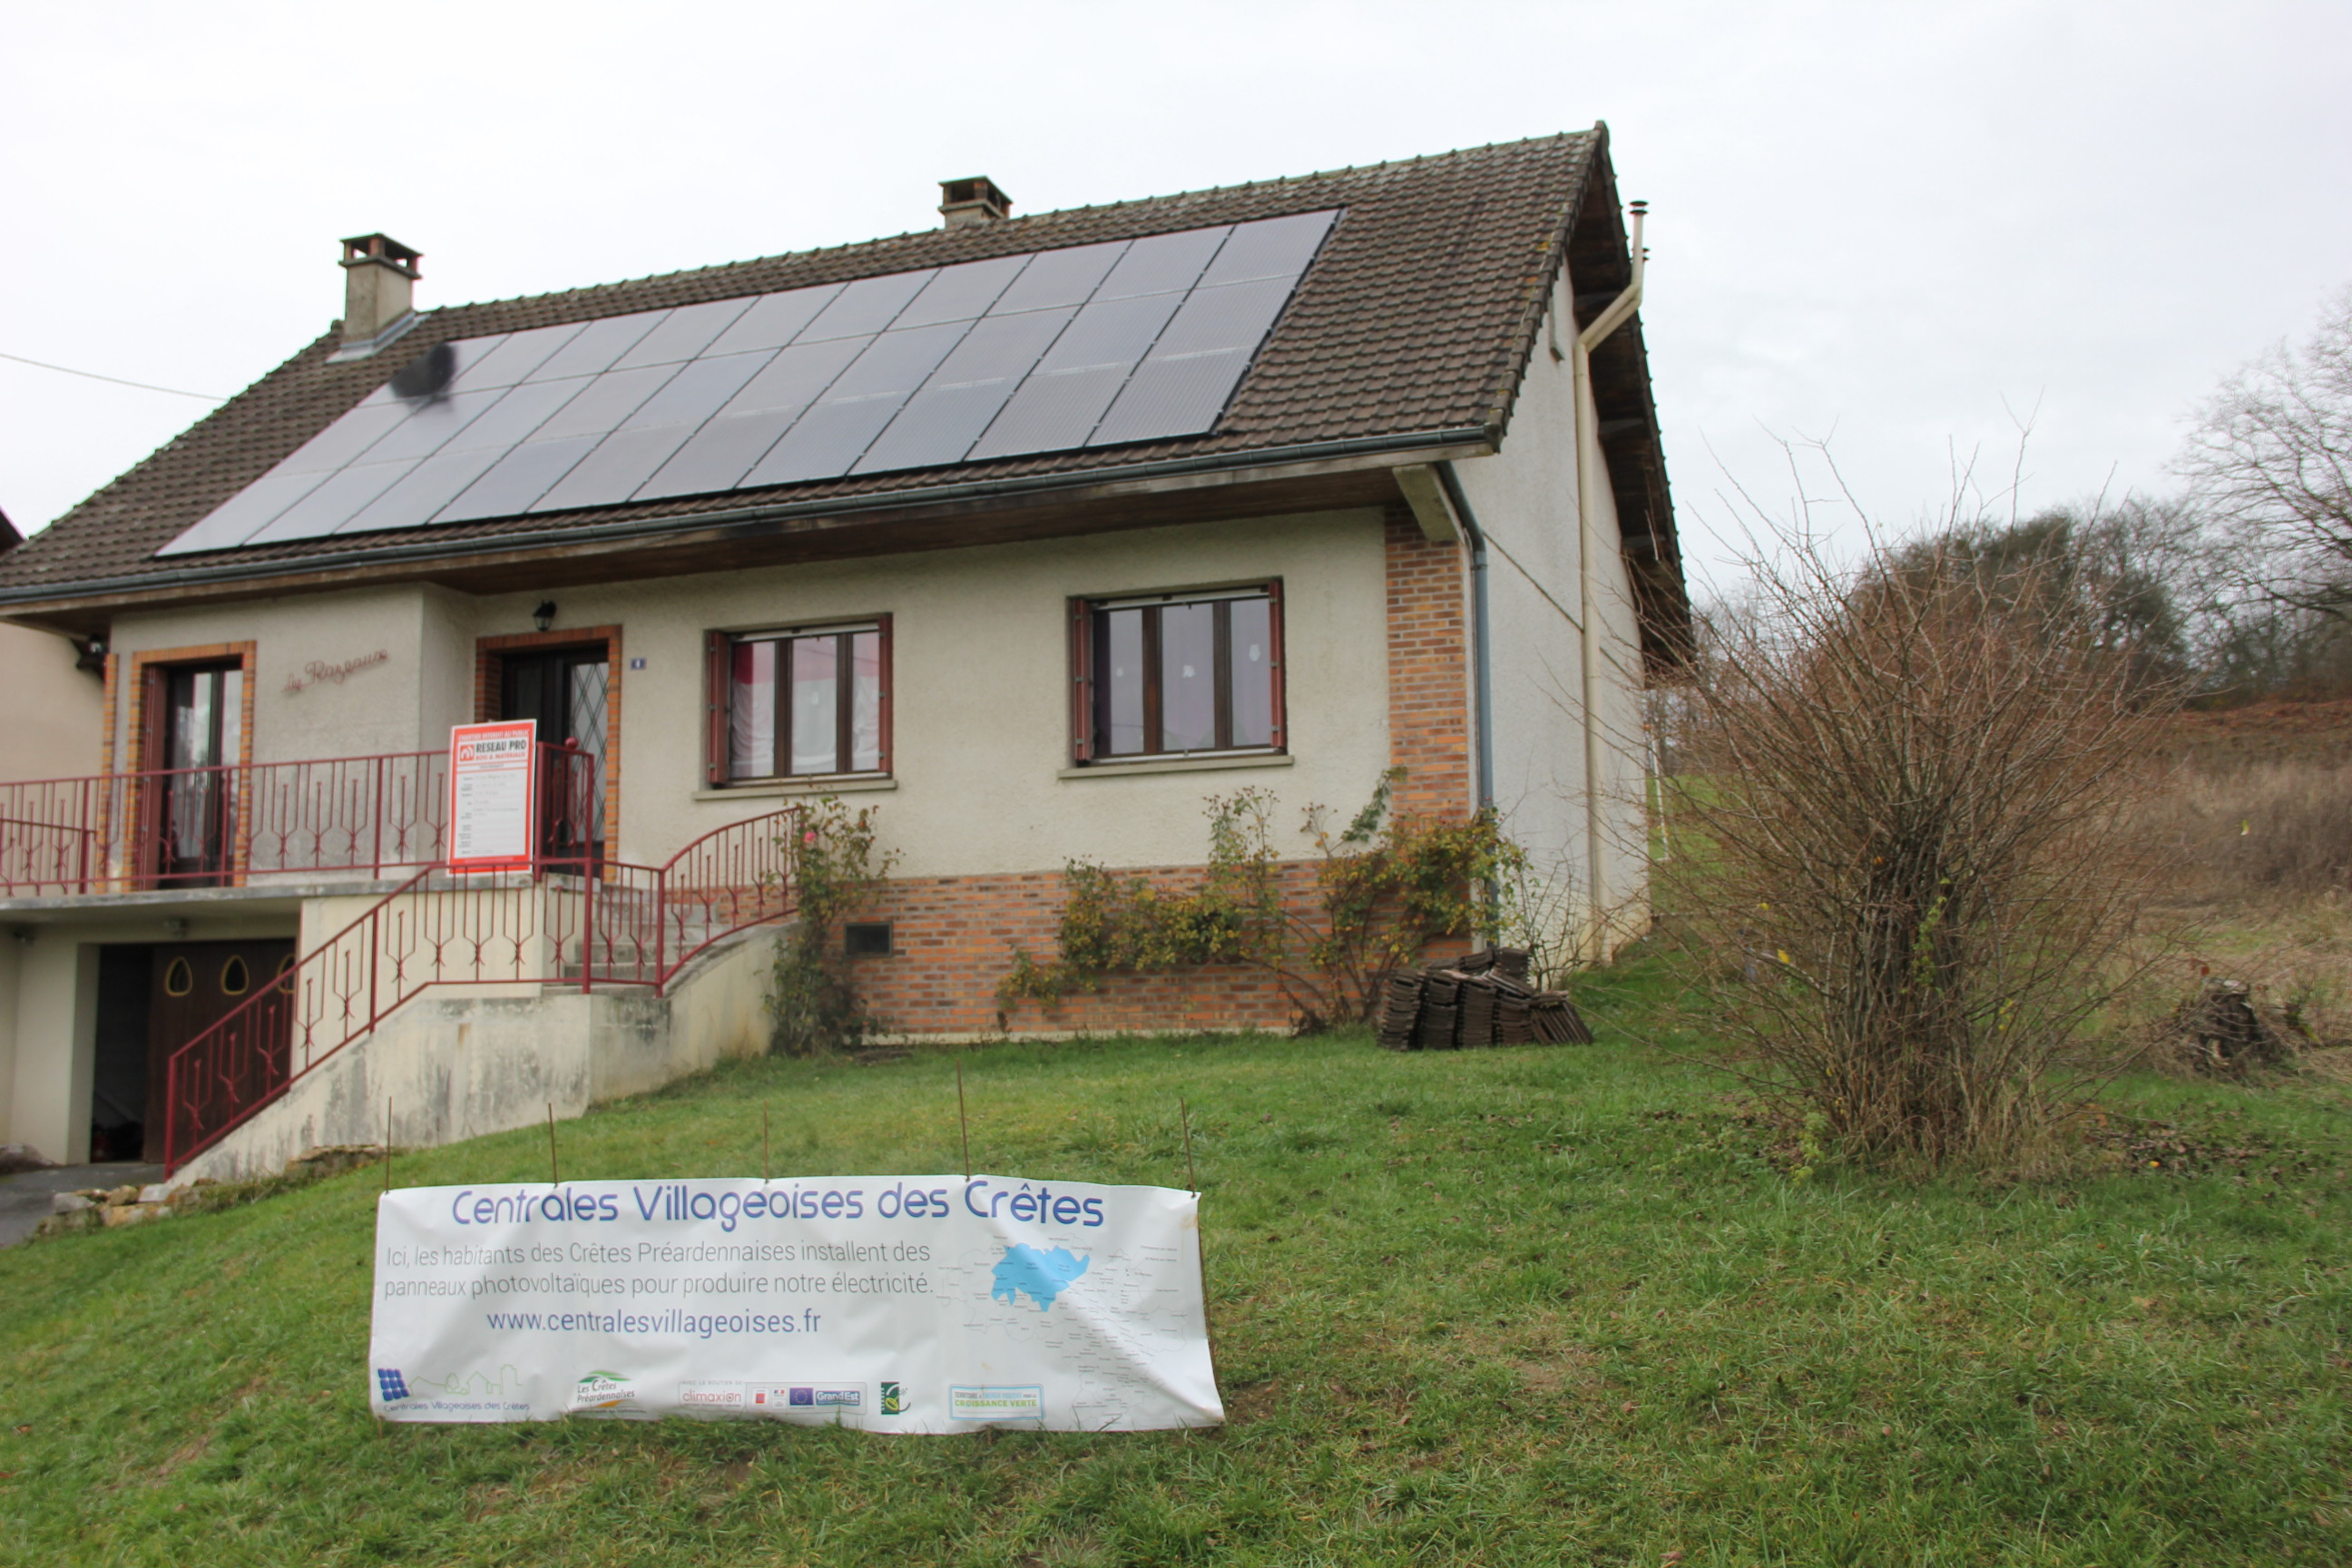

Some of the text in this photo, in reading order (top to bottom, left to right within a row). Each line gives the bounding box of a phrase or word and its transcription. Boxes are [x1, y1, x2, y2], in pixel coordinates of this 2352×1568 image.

[476, 740, 526, 752] RESEAU PRO
[453, 1180, 1104, 1232] Centrales Villageoises des Crêtes
[387, 1240, 931, 1268] Ici, les habitants des Crêtes Préardennaises installent des
[385, 1271, 934, 1300] panneaux photovoltaïques pour produire notre électricité.
[486, 1308, 821, 1339] www.centralesvillageoises.fr
[577, 1379, 617, 1393] Les Crêtes
[577, 1389, 636, 1403] Préardennaises
[682, 1388, 742, 1403] climaxion
[384, 1402, 429, 1413] Centrales
[431, 1400, 483, 1413] Villageoises
[485, 1400, 502, 1410] des
[955, 1399, 1038, 1407] CROISSANCE VERTE
